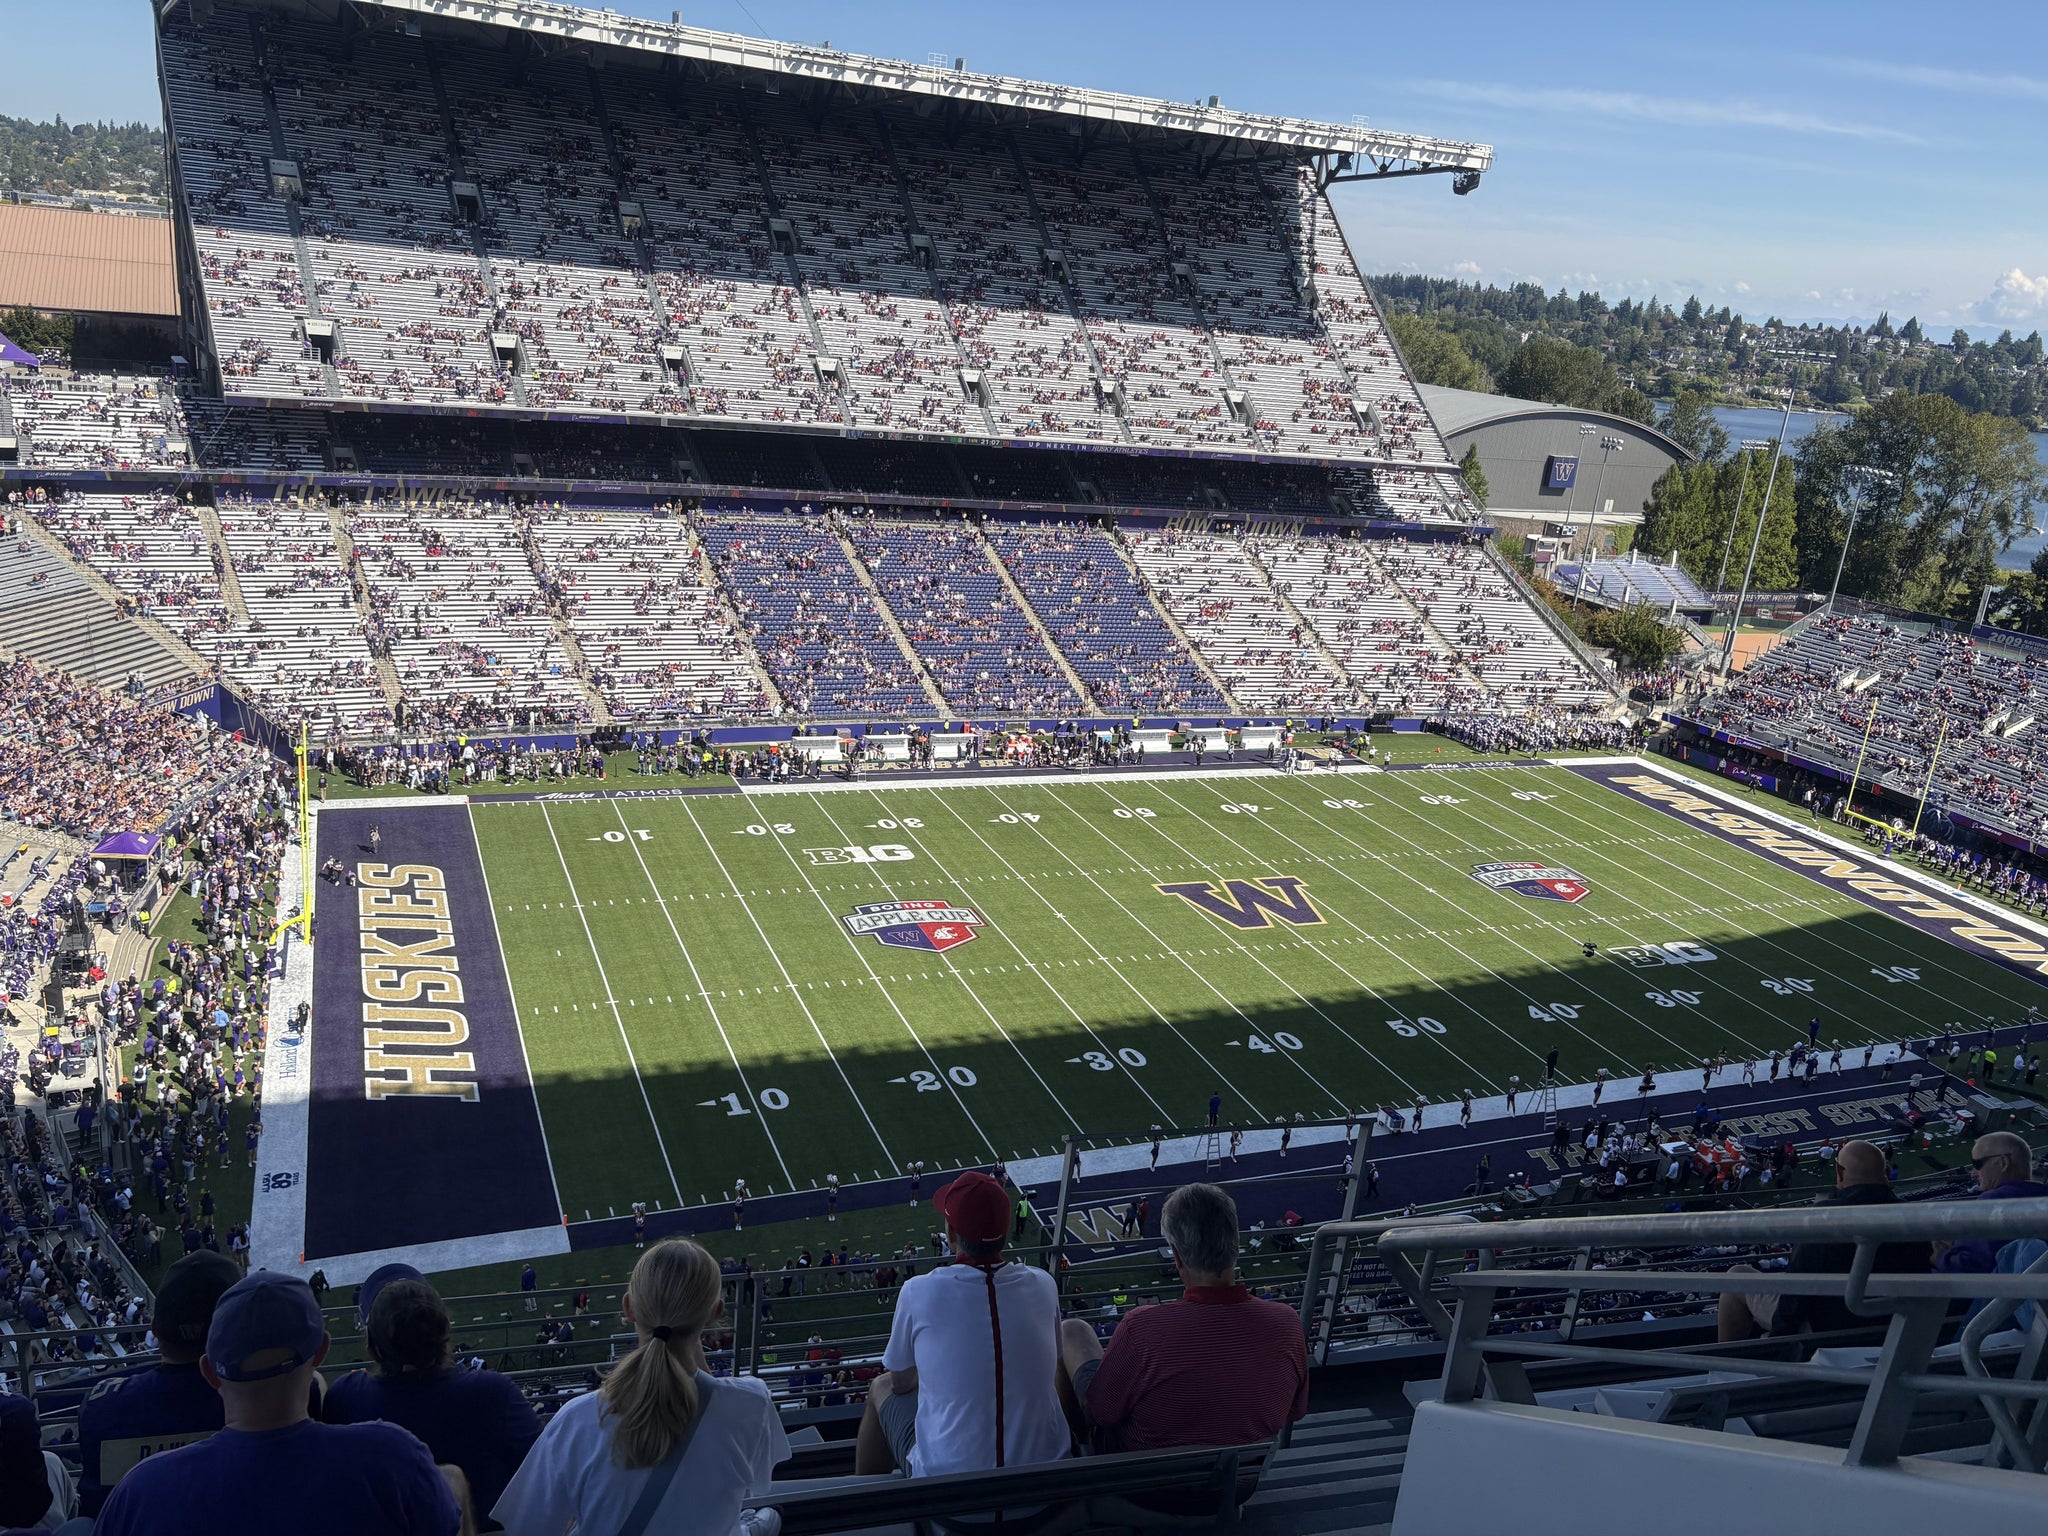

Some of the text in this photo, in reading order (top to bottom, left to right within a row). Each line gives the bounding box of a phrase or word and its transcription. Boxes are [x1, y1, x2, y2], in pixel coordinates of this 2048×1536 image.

[1556, 462, 1574, 481] W
[1988, 632, 2023, 647] 2009
[180, 686, 215, 710] DOWN!
[534, 788, 683, 799] Alaska ATMOS
[869, 901, 936, 912] BOEING
[1151, 875, 1328, 930] W
[855, 909, 974, 930] APPLE CUP
[887, 930, 921, 943] W
[357, 862, 481, 1103] HUSKIES
[1870, 965, 1920, 983] 10
[1760, 976, 1815, 996] 20
[1644, 988, 1701, 1009] 30
[1527, 1002, 1580, 1022] 40
[1385, 1016, 1448, 1038] 50
[1246, 1031, 1304, 1054] 40
[279, 1048, 297, 1079] Holland
[1082, 1047, 1148, 1071] 30
[908, 1065, 978, 1093] 20
[720, 1087, 790, 1117] 10
[262, 1173, 272, 1193] ALASKA
